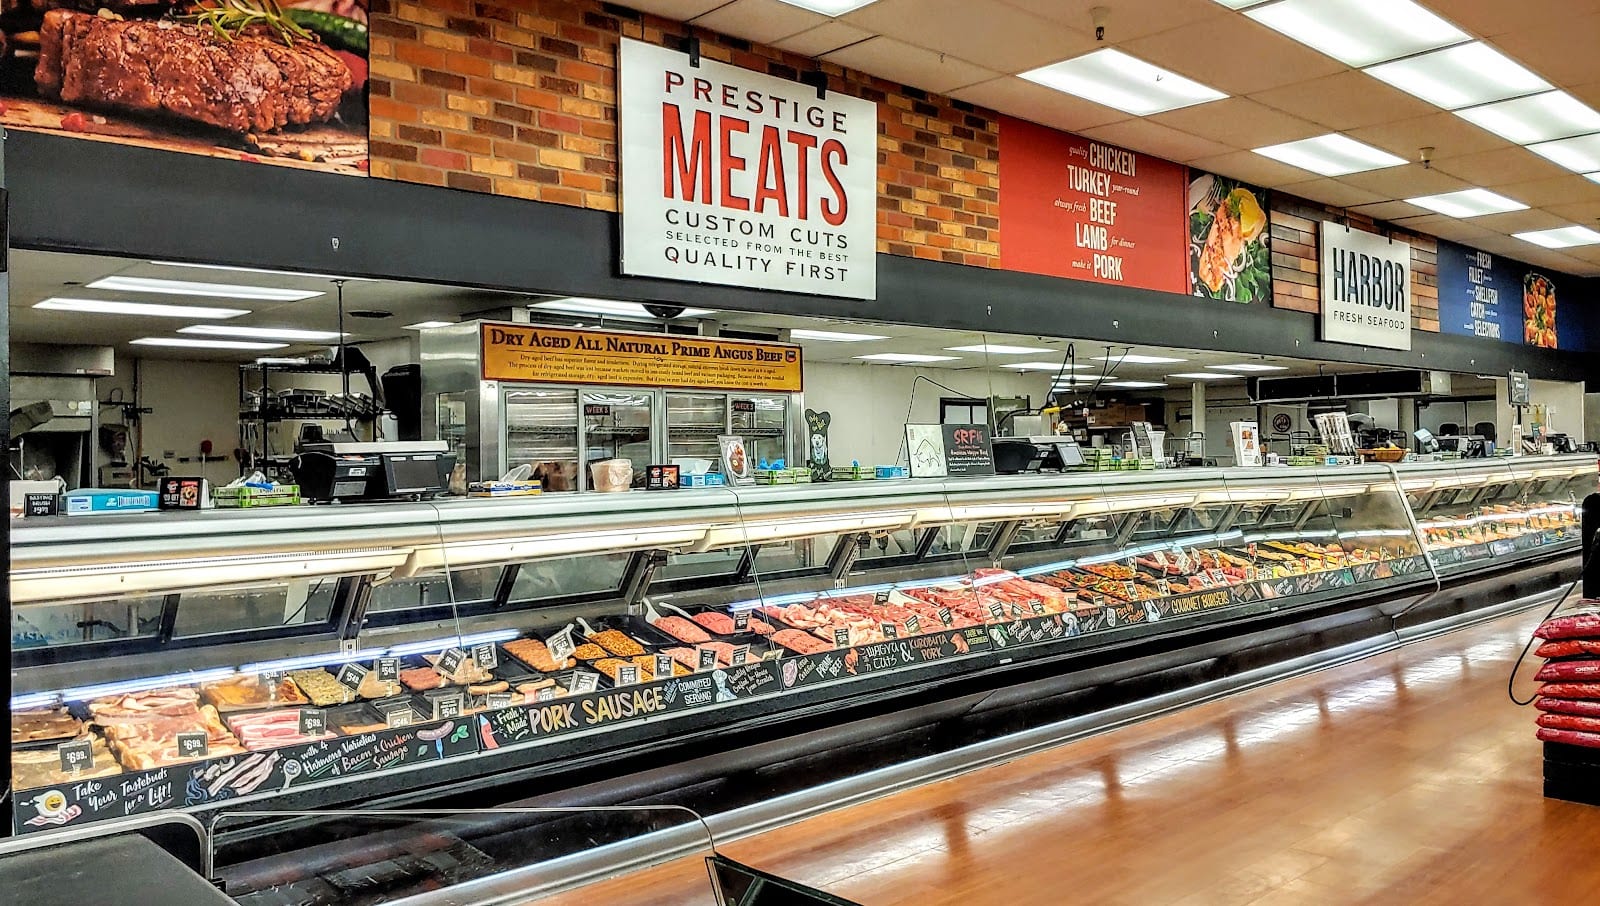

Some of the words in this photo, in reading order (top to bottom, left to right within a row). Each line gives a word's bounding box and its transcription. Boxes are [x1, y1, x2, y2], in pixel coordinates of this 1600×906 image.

[664, 70, 848, 135] PRESTIGE
[662, 101, 848, 227] MEATS
[1069, 146, 1089, 159] quality
[1089, 142, 1136, 177] CHICKEN
[1067, 164, 1111, 198] TURKEY
[1054, 197, 1073, 213] always
[1072, 200, 1087, 213] fresh
[1089, 197, 1117, 226] BEEF
[665, 207, 774, 239] CUSTOM
[790, 227, 848, 250] CUTS
[1075, 222, 1109, 252] LAMB
[1110, 236, 1118, 248] for
[1118, 237, 1136, 250] dinner
[666, 230, 739, 249] SELECTED
[746, 241, 783, 255] FROM
[789, 247, 812, 259] THE
[819, 251, 849, 264] BEST
[1476, 251, 1492, 270] FRESH
[664, 246, 773, 274] QUALITY
[786, 262, 848, 282] FIRST
[1071, 259, 1086, 270] make
[1086, 259, 1092, 270] it
[1093, 253, 1124, 282] PORK
[1468, 266, 1484, 285] FILLET
[1332, 247, 1405, 313] HARBOR
[1475, 285, 1499, 305] SHELLFISH
[1333, 310, 1363, 325] FRESH
[1367, 315, 1405, 331] SEAFOOD
[1470, 301, 1485, 319] CATCH
[1474, 319, 1501, 339] SELECTIONS
[491, 328, 525, 346] DRY
[529, 331, 571, 349] AGED
[575, 335, 603, 351] ALL
[606, 337, 669, 355] NATURAL
[672, 342, 711, 358] PRIME
[713, 345, 754, 361] ANGUS
[756, 348, 783, 362] BEEF
[1171, 595, 1201, 614] GOURMET
[1201, 590, 1230, 608] BURGERS
[866, 642, 900, 658] WAGYU
[899, 641, 915, 662] &
[908, 634, 948, 650] KUROBUTA
[920, 647, 945, 661] PORK
[728, 668, 747, 684] Quality
[815, 653, 834, 679] PRIME
[829, 656, 844, 677] BEEF
[755, 673, 775, 687] Scratch
[529, 701, 579, 735] PORK
[581, 686, 667, 725] SAUSAGE
[684, 690, 712, 705] SERVING
[496, 707, 519, 725] Fresh
[505, 717, 529, 735] Made
[300, 745, 319, 761] with
[320, 740, 329, 751] 4
[302, 749, 342, 775] Harmons
[341, 733, 377, 754] Varieties
[331, 763, 341, 775] of
[341, 749, 373, 772] Bacon
[373, 745, 380, 755] &
[379, 732, 415, 754] Chicken
[373, 745, 409, 770] Sausage
[71, 781, 102, 801] Take
[88, 793, 118, 812] Your
[119, 768, 168, 798] Tastebuds
[124, 799, 136, 815] for
[136, 794, 145, 804] a
[148, 783, 172, 807] Lift!
